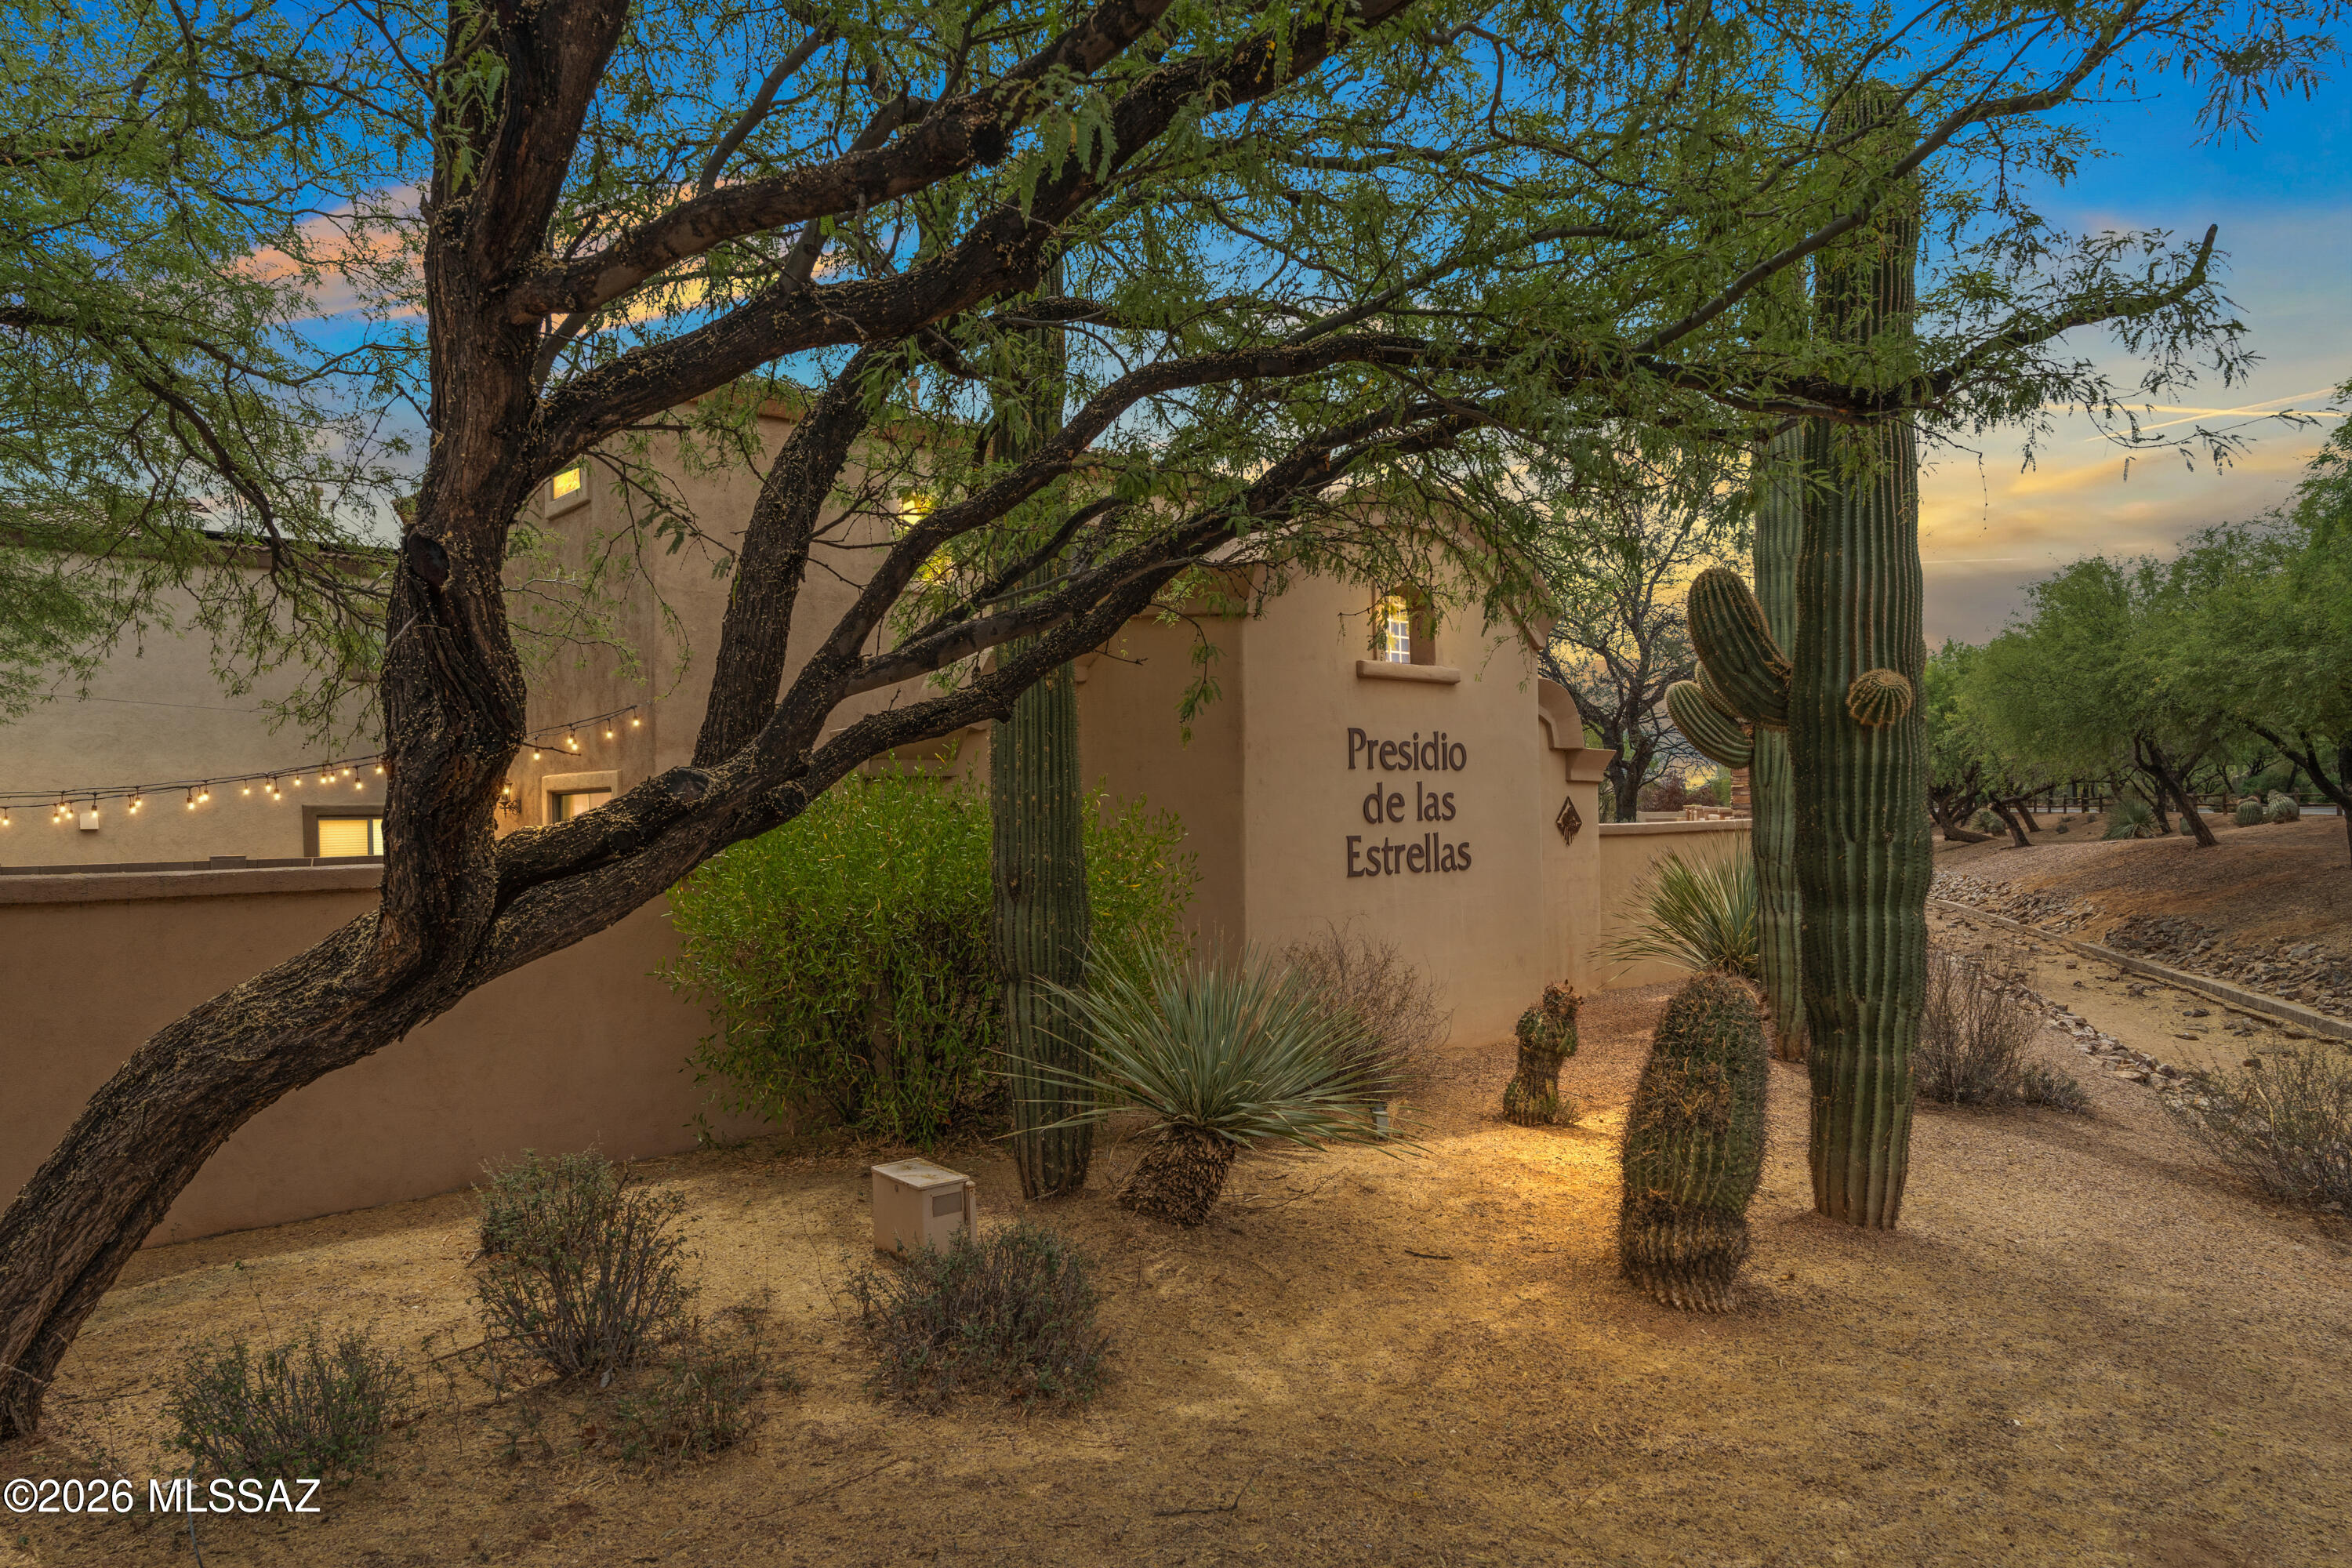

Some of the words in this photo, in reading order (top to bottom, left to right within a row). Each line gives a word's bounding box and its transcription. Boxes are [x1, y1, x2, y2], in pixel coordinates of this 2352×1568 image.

[1347, 728, 1467, 771] Presidio
[1363, 782, 1405, 823] de
[1416, 781, 1457, 822] las
[1346, 832, 1472, 878] Estrellas
